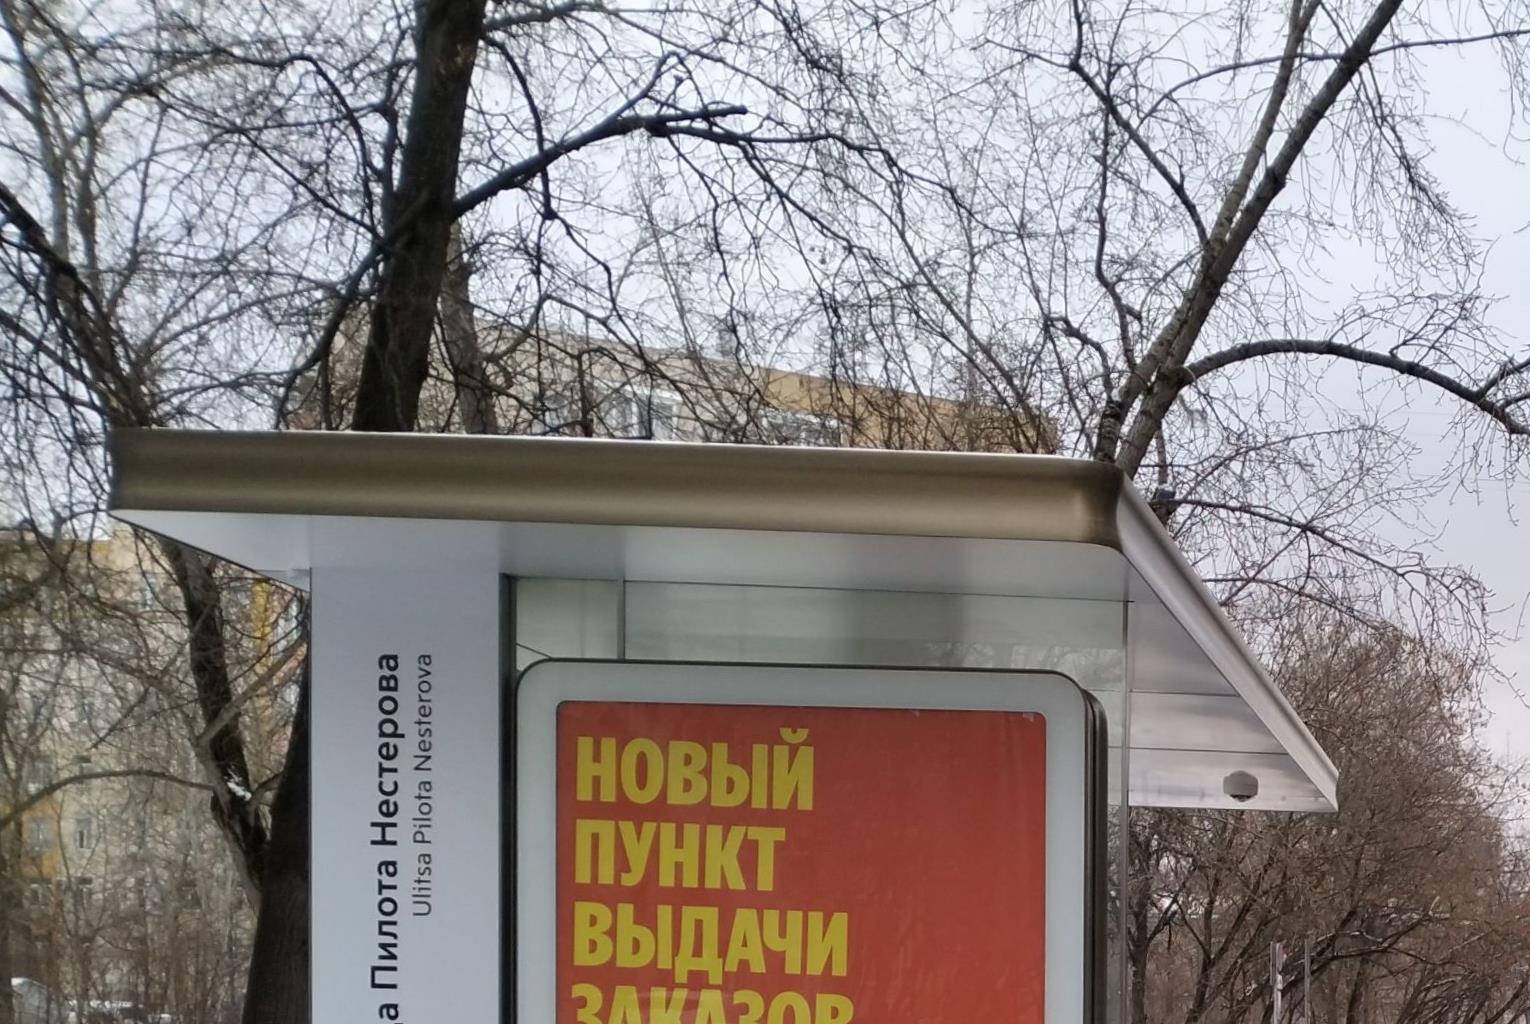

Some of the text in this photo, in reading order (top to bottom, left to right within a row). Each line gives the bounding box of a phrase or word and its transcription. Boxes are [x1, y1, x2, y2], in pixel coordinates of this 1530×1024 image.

[370, 652, 405, 847] Нестерова
[413, 653, 432, 917] Ulitsa Pilota Nesterova
[576, 727, 814, 811] НОВЫЙ
[574, 818, 786, 891] ПУНКТ
[370, 860, 399, 990] Пилота
[573, 901, 849, 985] ВЫДАЧИ
